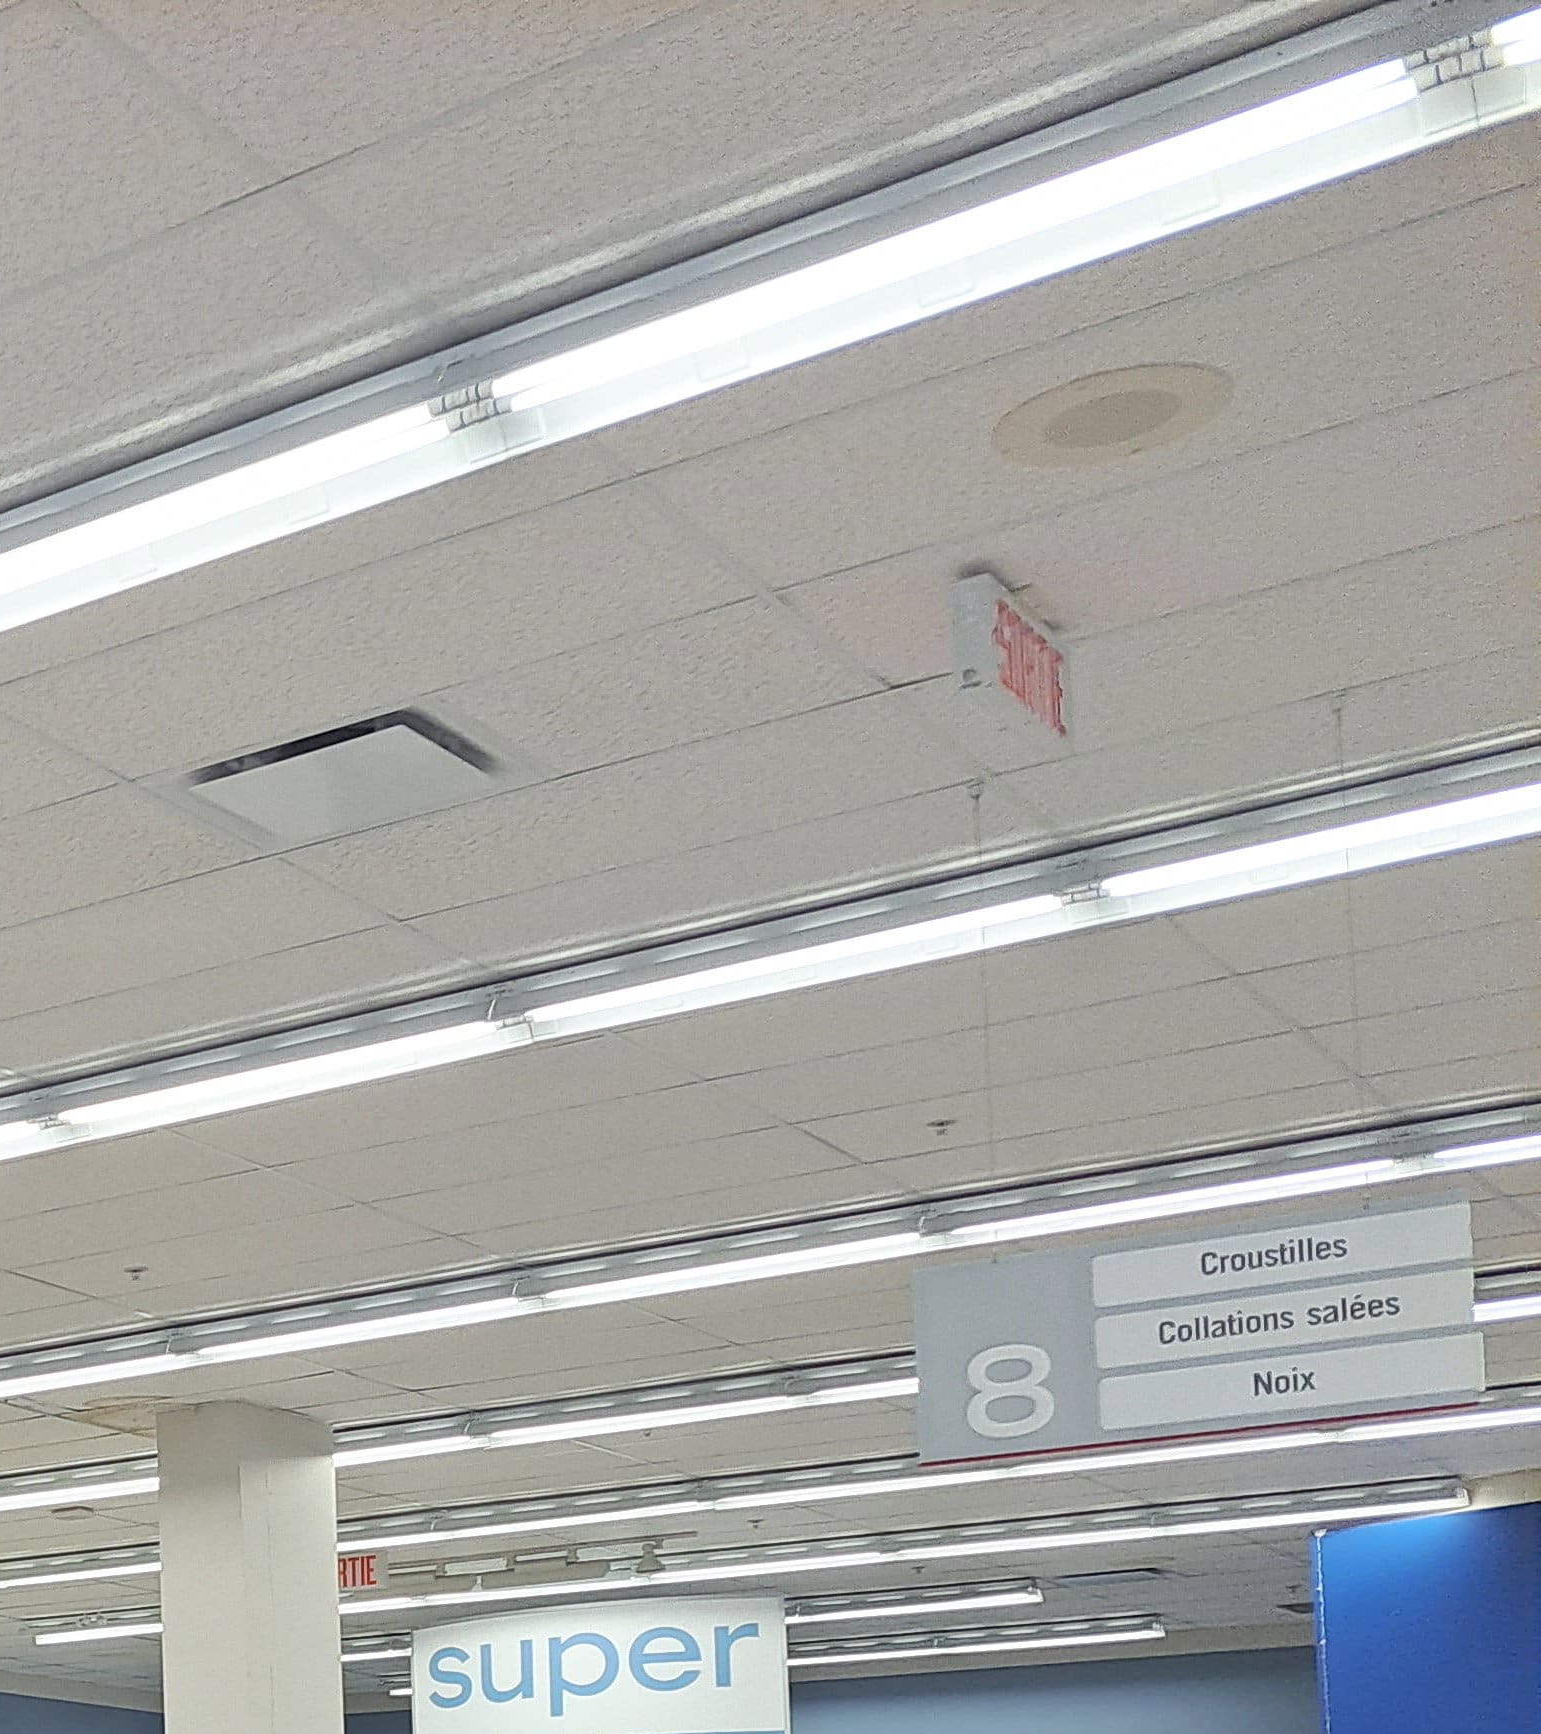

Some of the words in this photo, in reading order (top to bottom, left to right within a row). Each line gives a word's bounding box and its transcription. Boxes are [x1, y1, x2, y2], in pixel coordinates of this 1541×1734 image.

[1200, 1236, 1348, 1276] Croustilles
[1158, 1310, 1295, 1346] Collations
[1307, 1294, 1401, 1326] salées
[966, 1343, 1054, 1439] 8
[1253, 1367, 1316, 1397] Noix
[428, 1621, 759, 1718] super
